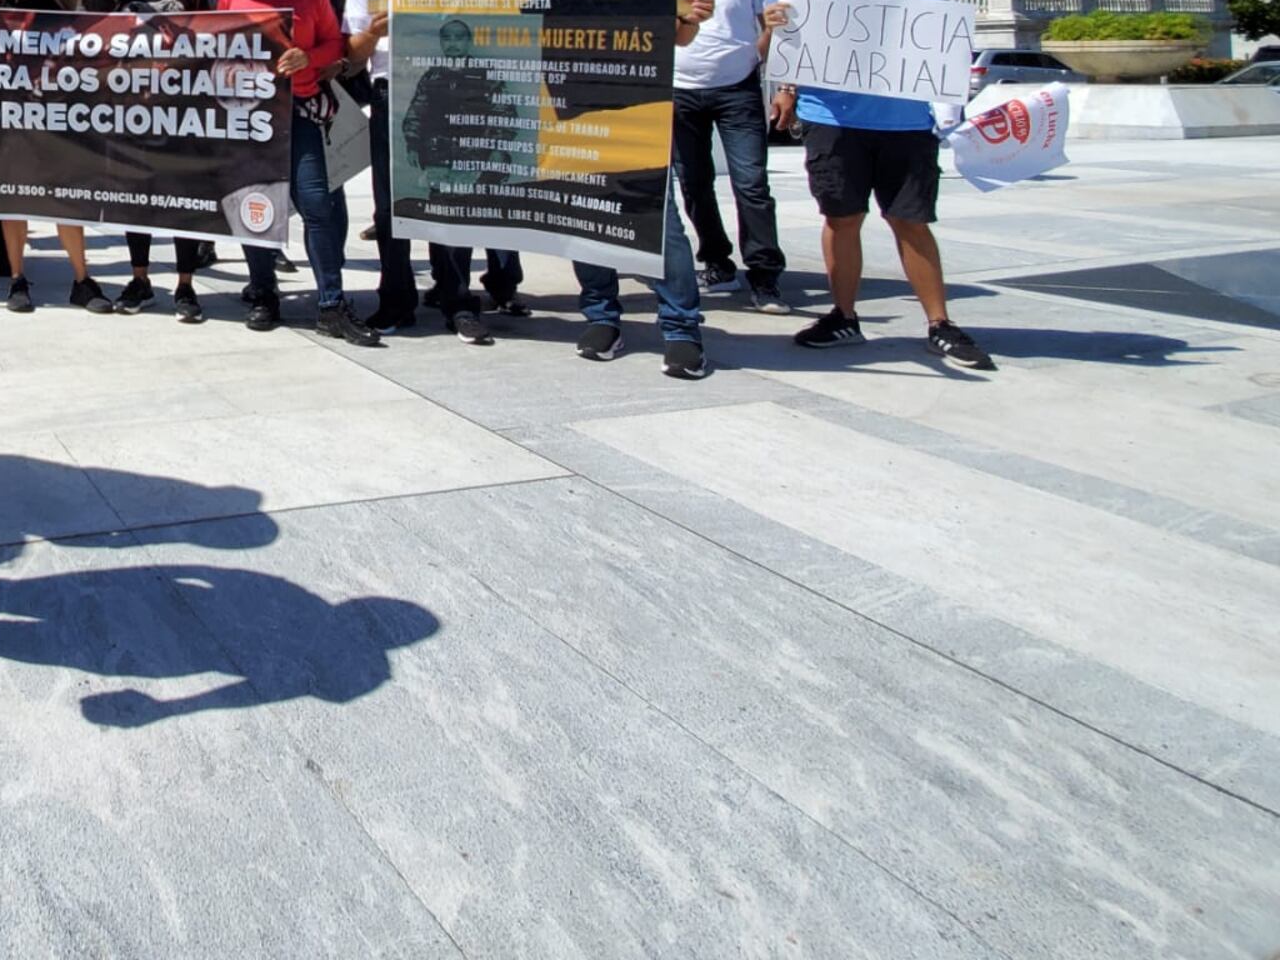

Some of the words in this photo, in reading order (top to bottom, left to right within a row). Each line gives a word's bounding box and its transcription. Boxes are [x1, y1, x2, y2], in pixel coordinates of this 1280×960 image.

[108, 32, 272, 60] SALARIAL
[474, 26, 490, 46] NI
[496, 26, 532, 49] UNA
[538, 28, 607, 50] MUERTE
[612, 26, 654, 53] MÁS
[412, 56, 454, 68] IGUALDAD
[455, 58, 467, 69] DE
[468, 58, 519, 71] BENEFICIOS
[519, 59, 570, 73] LABORALES
[572, 62, 628, 76] OTORGADOS
[629, 65, 637, 76] A
[638, 65, 657, 77] LOS
[770, 37, 962, 98] SALARIAL
[40, 65, 100, 93] LOS
[107, 67, 277, 100] OFICIALES
[492, 93, 523, 106] AJUSTE
[524, 95, 568, 109] SALARIAL
[449, 114, 486, 126] MEJORES
[487, 115, 555, 131] HERRAMIENTAS
[570, 123, 610, 138] TRABAJO
[459, 136, 497, 149] MEJORES
[497, 139, 535, 154] EQUIPOS
[549, 145, 600, 161] SEGURIDAD
[452, 160, 530, 177] ADIESTRAMIENTOS
[17, 184, 46, 197] 3500
[54, 187, 92, 201] SPUPR
[93, 190, 148, 206] CONCILIO
[150, 194, 218, 212] 95/AFSCME
[475, 184, 487, 194] DE
[488, 184, 525, 198] TRABAJO
[527, 187, 561, 203] SEGURA
[562, 193, 570, 205] Y
[570, 194, 623, 215] SALUDABLE
[424, 203, 465, 218] AMBIENTE
[466, 206, 504, 219] LABORAL
[507, 209, 532, 221] LIBRE
[533, 211, 546, 223] DE
[547, 213, 596, 232] DISCRIMEN
[596, 223, 604, 234] Y
[604, 225, 636, 241] ACOSO
